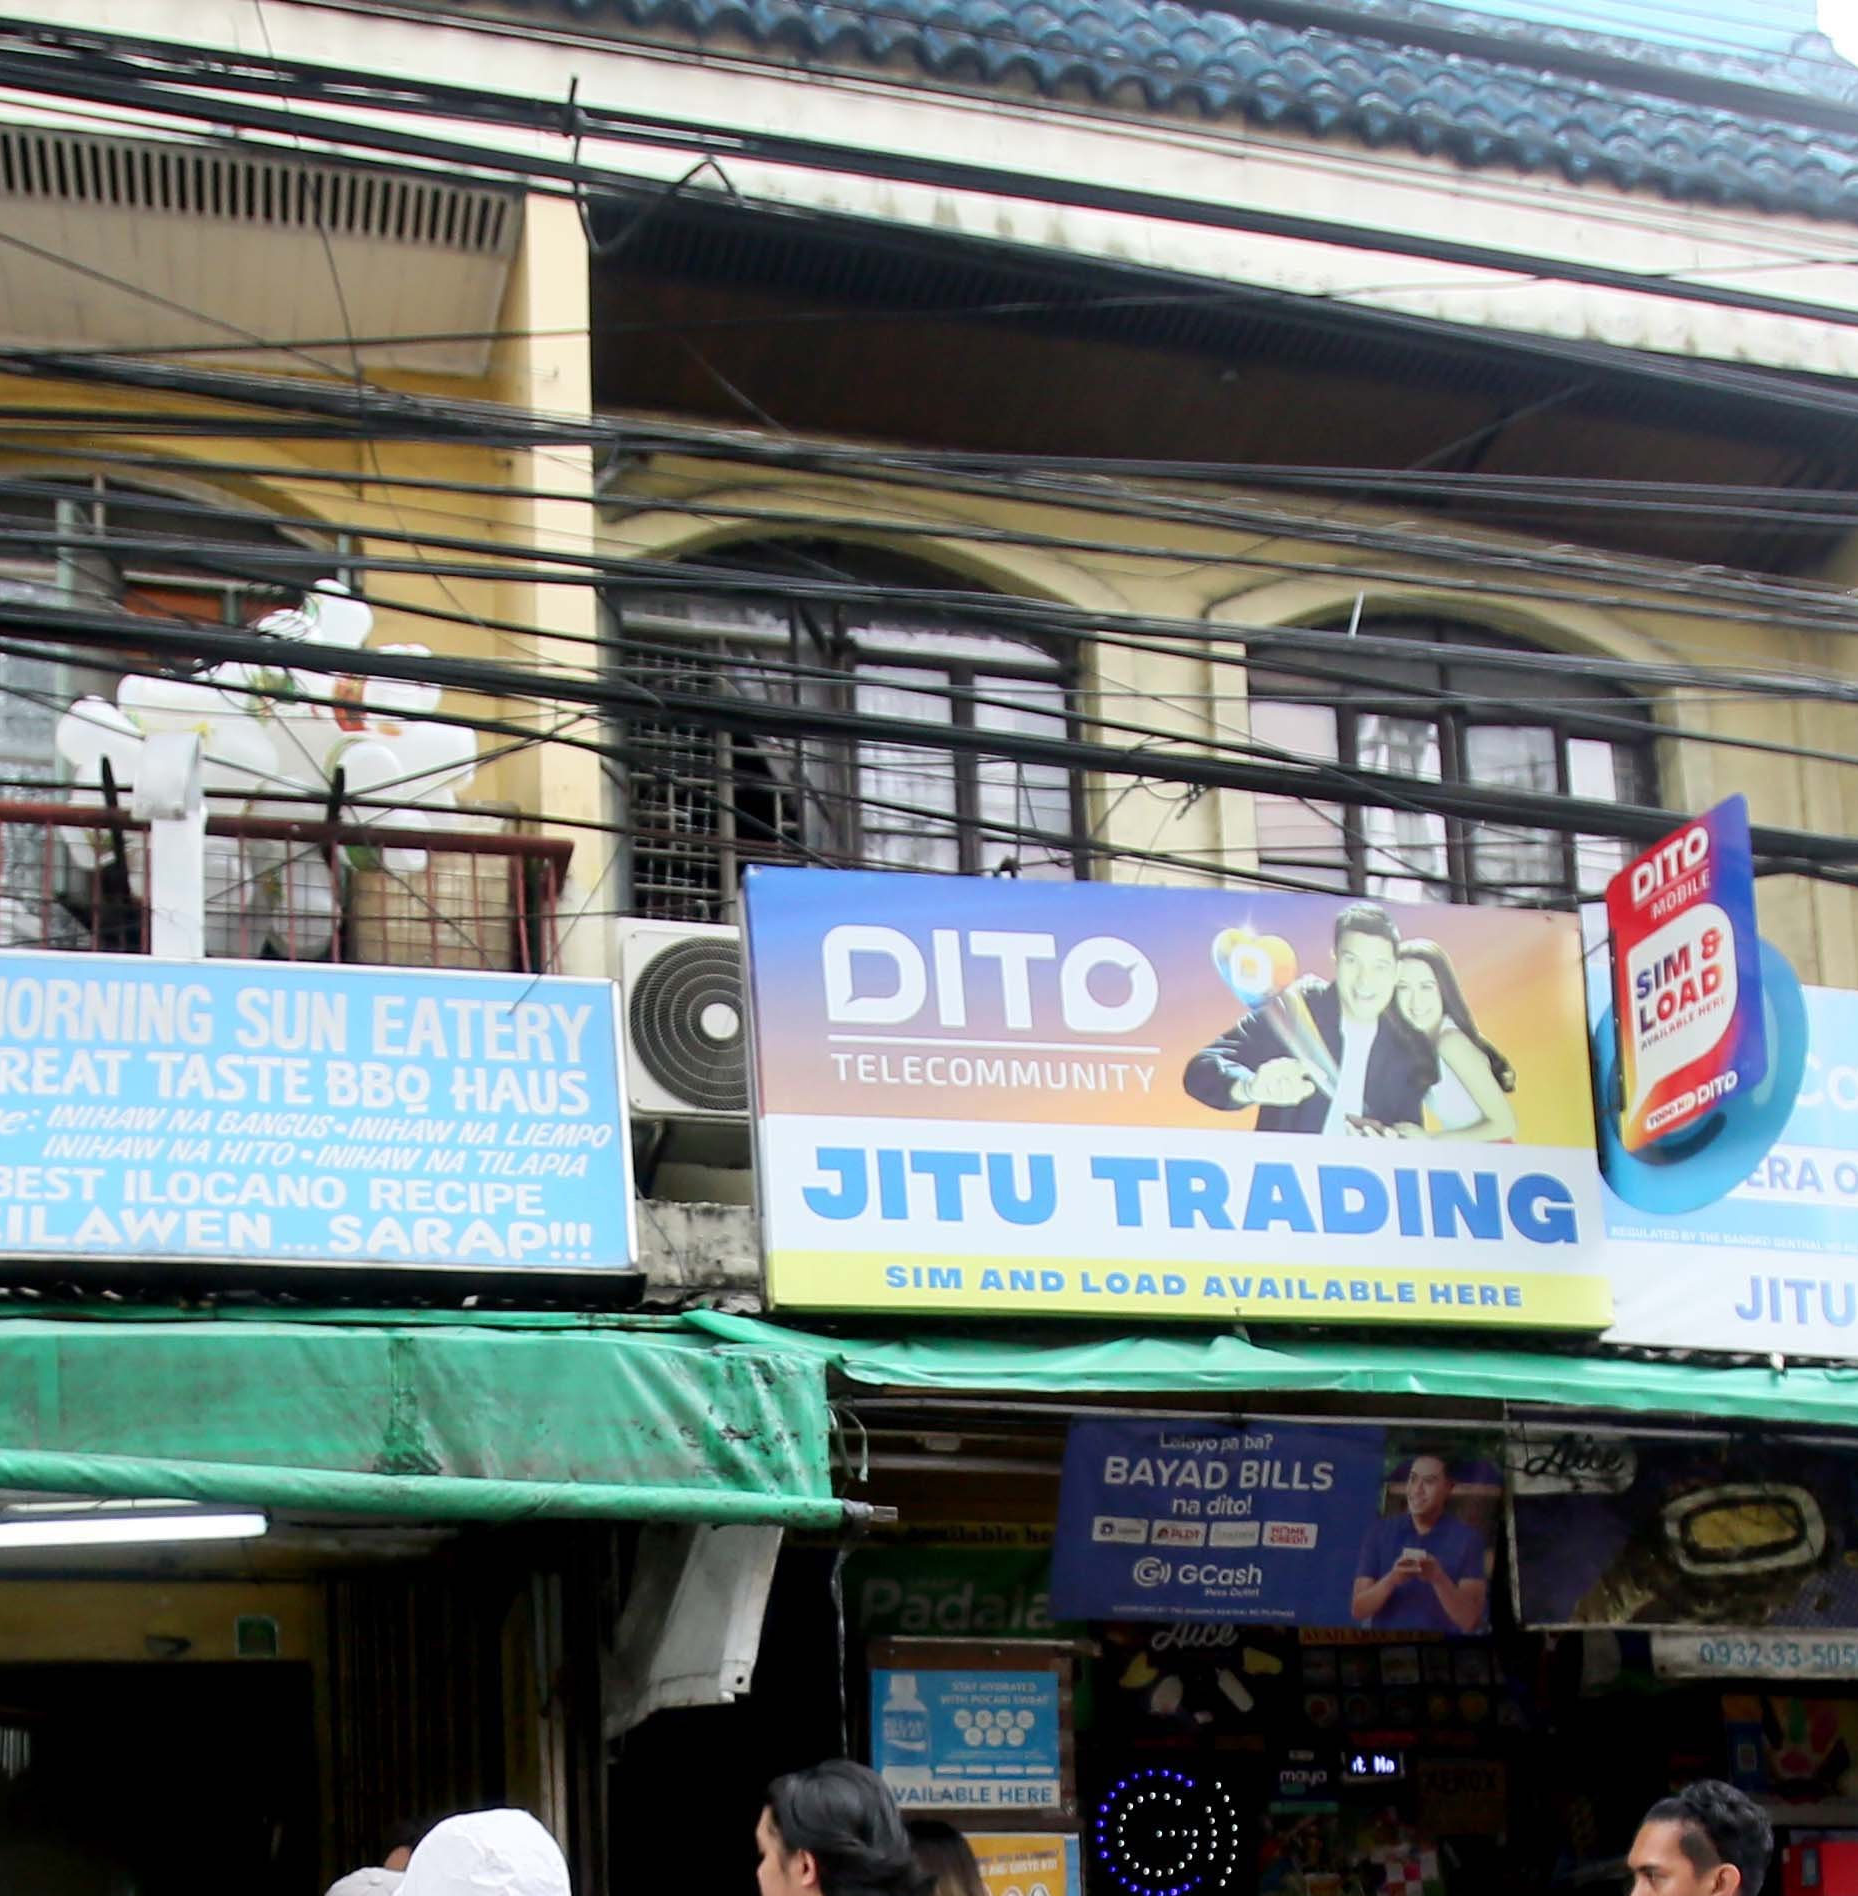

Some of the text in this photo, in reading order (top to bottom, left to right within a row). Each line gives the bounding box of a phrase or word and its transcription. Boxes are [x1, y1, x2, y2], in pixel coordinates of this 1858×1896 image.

[1632, 826, 1710, 903] DITO
[1651, 867, 1710, 920] MOBILE
[822, 923, 1160, 1034] DITO
[1635, 927, 1725, 1000] SIM &
[1639, 963, 1723, 1035] LOAD
[237, 988, 347, 1053] SUN
[373, 995, 592, 1064] EATERY
[1641, 1015, 1696, 1052] AVAILABLE
[146, 1051, 312, 1104] TASTE
[325, 1061, 431, 1114] BBQ
[449, 1066, 590, 1117] HAUS
[830, 1051, 1156, 1094] TELECOMMUNITY
[1697, 1070, 1738, 1105] DITO
[46, 1103, 613, 1149] INIHAW NA BANGUS INIHAW NA LIEMPO
[41, 1135, 589, 1178] INIHAW NA HITO INIHAW NA TILAPIA
[123, 1168, 348, 1210] ILOCANO
[369, 1179, 546, 1216] RECIPE
[802, 1145, 1579, 1246] JITU TRADING
[329, 1214, 592, 1261] SARAP!!!
[885, 1265, 1523, 1308] SIM AND LOAD AVAILABLE HERE
[1735, 1275, 1857, 1328] JITU
[1244, 1432, 1273, 1451] ba?
[1103, 1455, 1335, 1492] BAYAD BILLS
[1171, 1494, 1252, 1516] na dito!
[1178, 1563, 1263, 1587] GCash
[891, 1785, 1053, 1804] VAILABLE HERE
